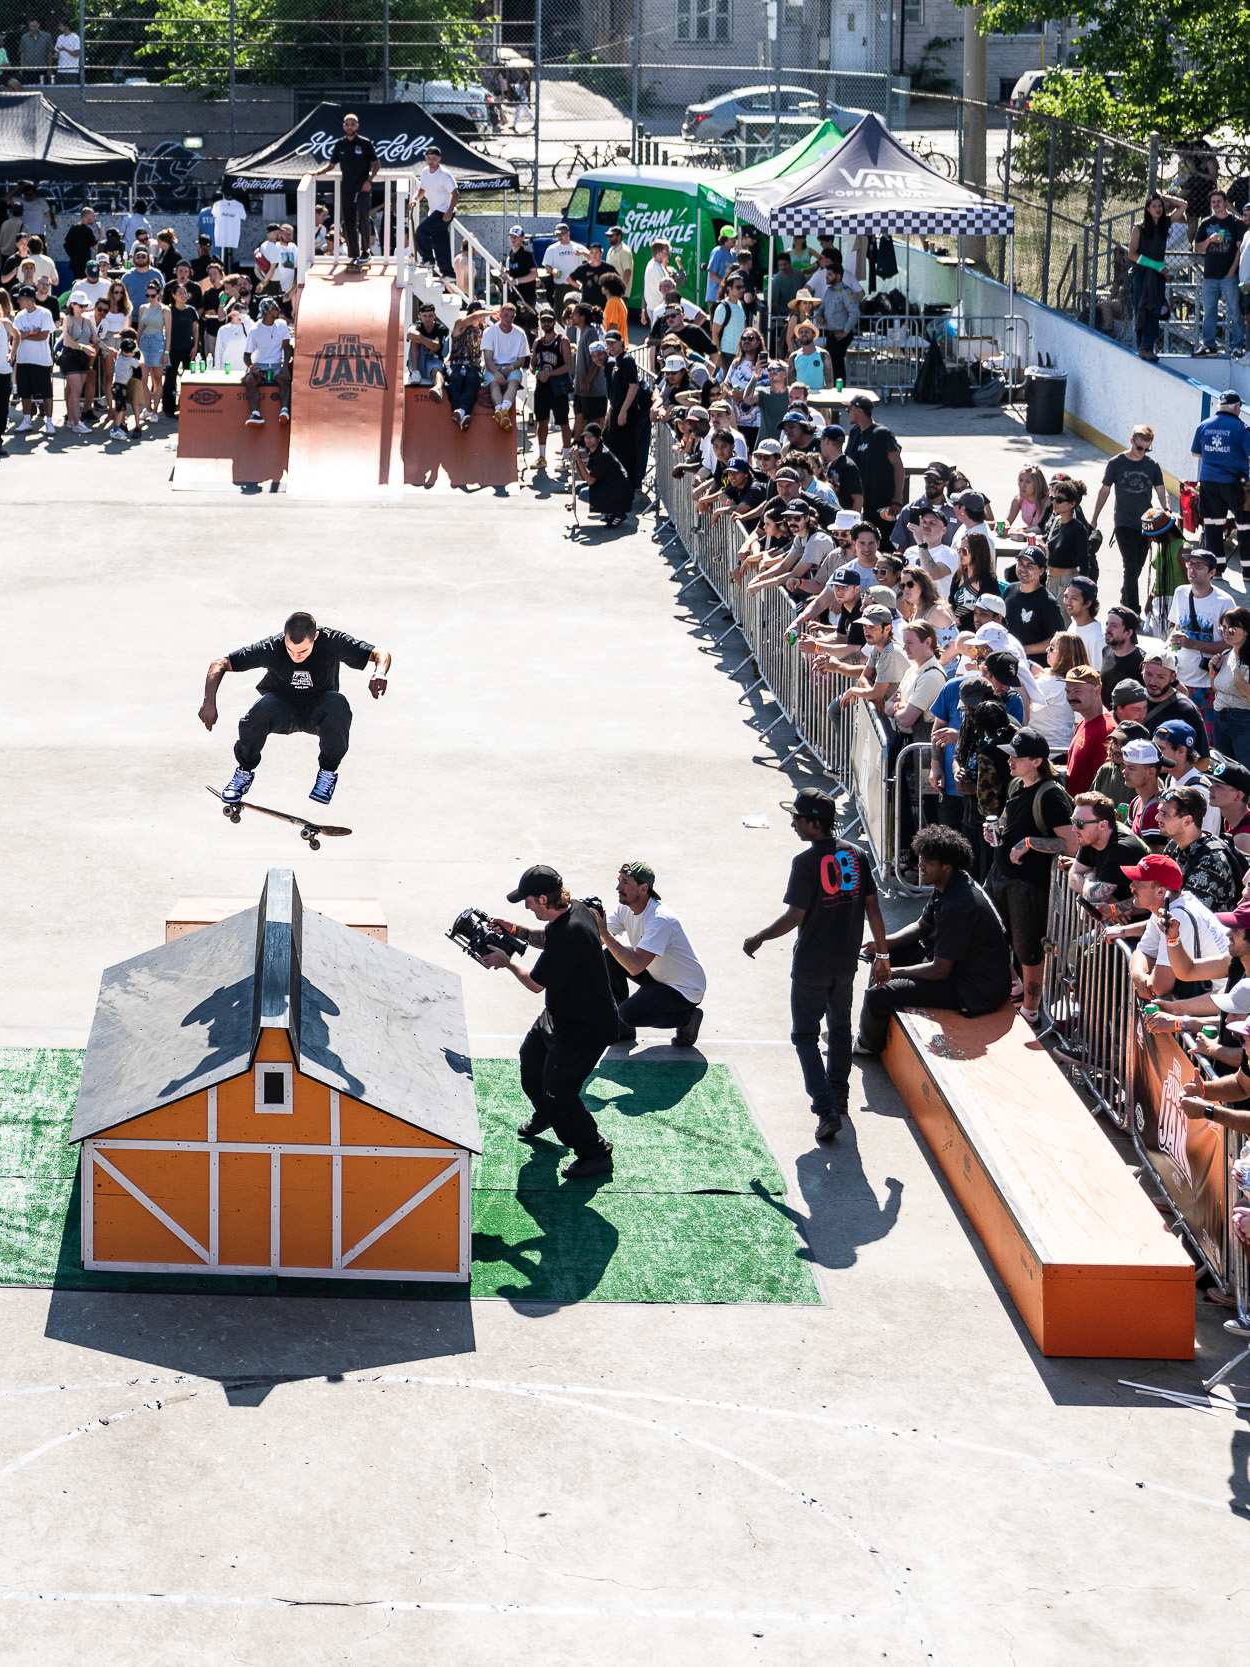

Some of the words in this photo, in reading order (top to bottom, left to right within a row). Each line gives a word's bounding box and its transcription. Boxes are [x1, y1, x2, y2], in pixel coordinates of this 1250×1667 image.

[838, 168, 925, 189] VANS
[621, 208, 674, 234] STEAM
[627, 223, 697, 254] WHISTLE
[323, 344, 372, 360] BUNT
[312, 358, 385, 387] JAM
[1204, 429, 1231, 437] EMERGENCY
[1204, 444, 1231, 453] RESPONDER
